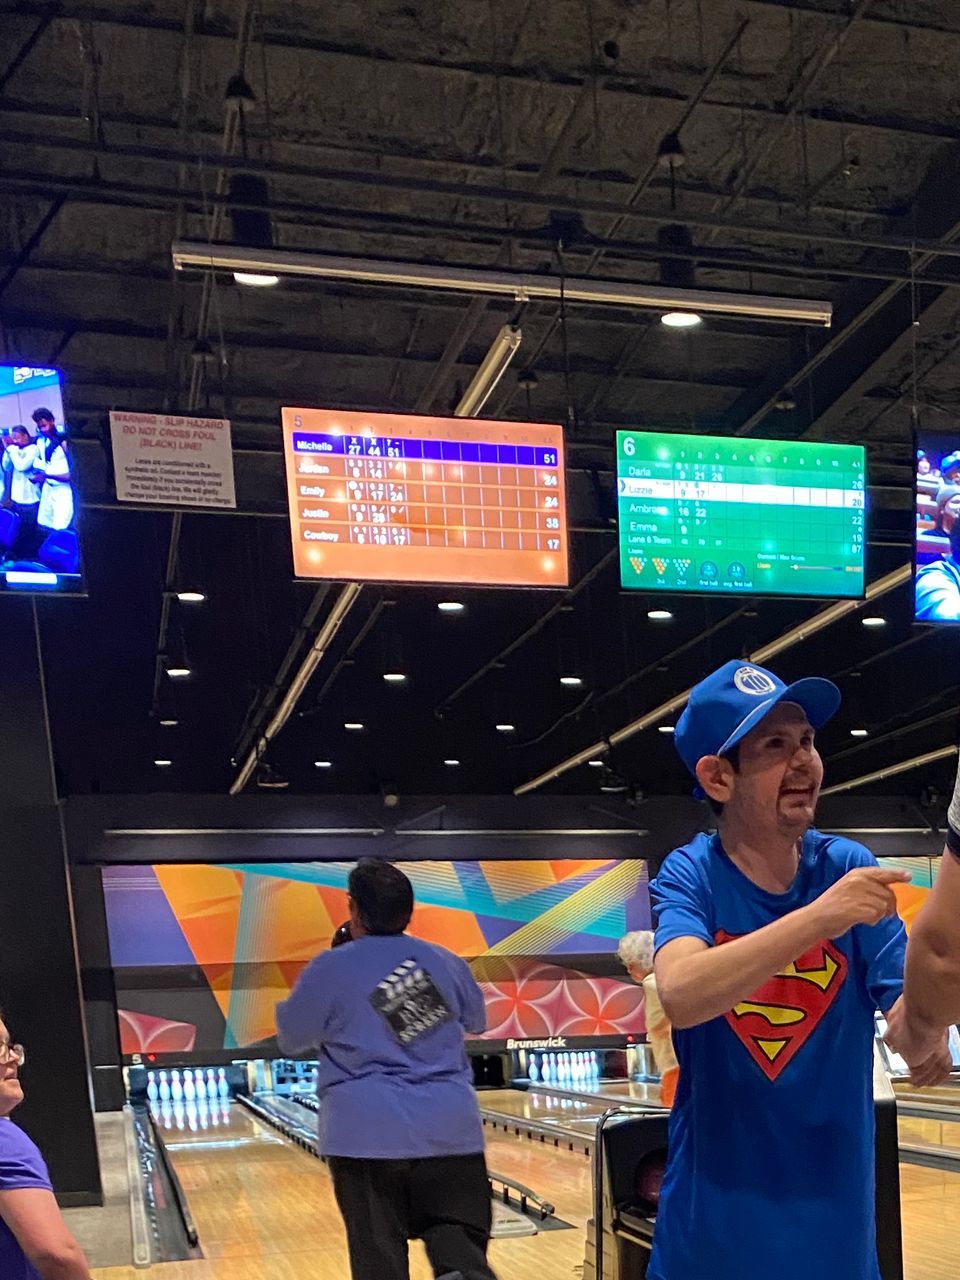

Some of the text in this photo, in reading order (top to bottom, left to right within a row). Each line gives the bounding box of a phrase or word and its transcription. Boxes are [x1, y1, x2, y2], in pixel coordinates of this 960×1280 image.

[113, 413, 156, 425] WARNING
[164, 416, 184, 426] SLIP
[186, 418, 224, 429] HAZARD
[294, 415, 302, 428] 5
[140, 426, 156, 436] NOT
[159, 428, 190, 438] CROSS
[193, 430, 216, 440] FOUL
[297, 440, 333, 450] Michelle
[624, 437, 636, 456] 6
[349, 446, 556, 464] 27 44 51 51
[629, 486, 652, 495] Lizzie
[852, 481, 862, 489] 26
[371, 491, 383, 500] 17
[390, 492, 403, 502] 24
[545, 496, 558, 507] 24
[546, 518, 559, 528] 38
[696, 508, 706, 517] 22
[852, 516, 862, 525] 22
[630, 522, 657, 532] Emma
[394, 535, 406, 545] 17
[547, 539, 559, 549] 17
[853, 534, 862, 542] 19
[506, 1036, 566, 1049] Brunswick
[132, 1054, 142, 1064] 5
